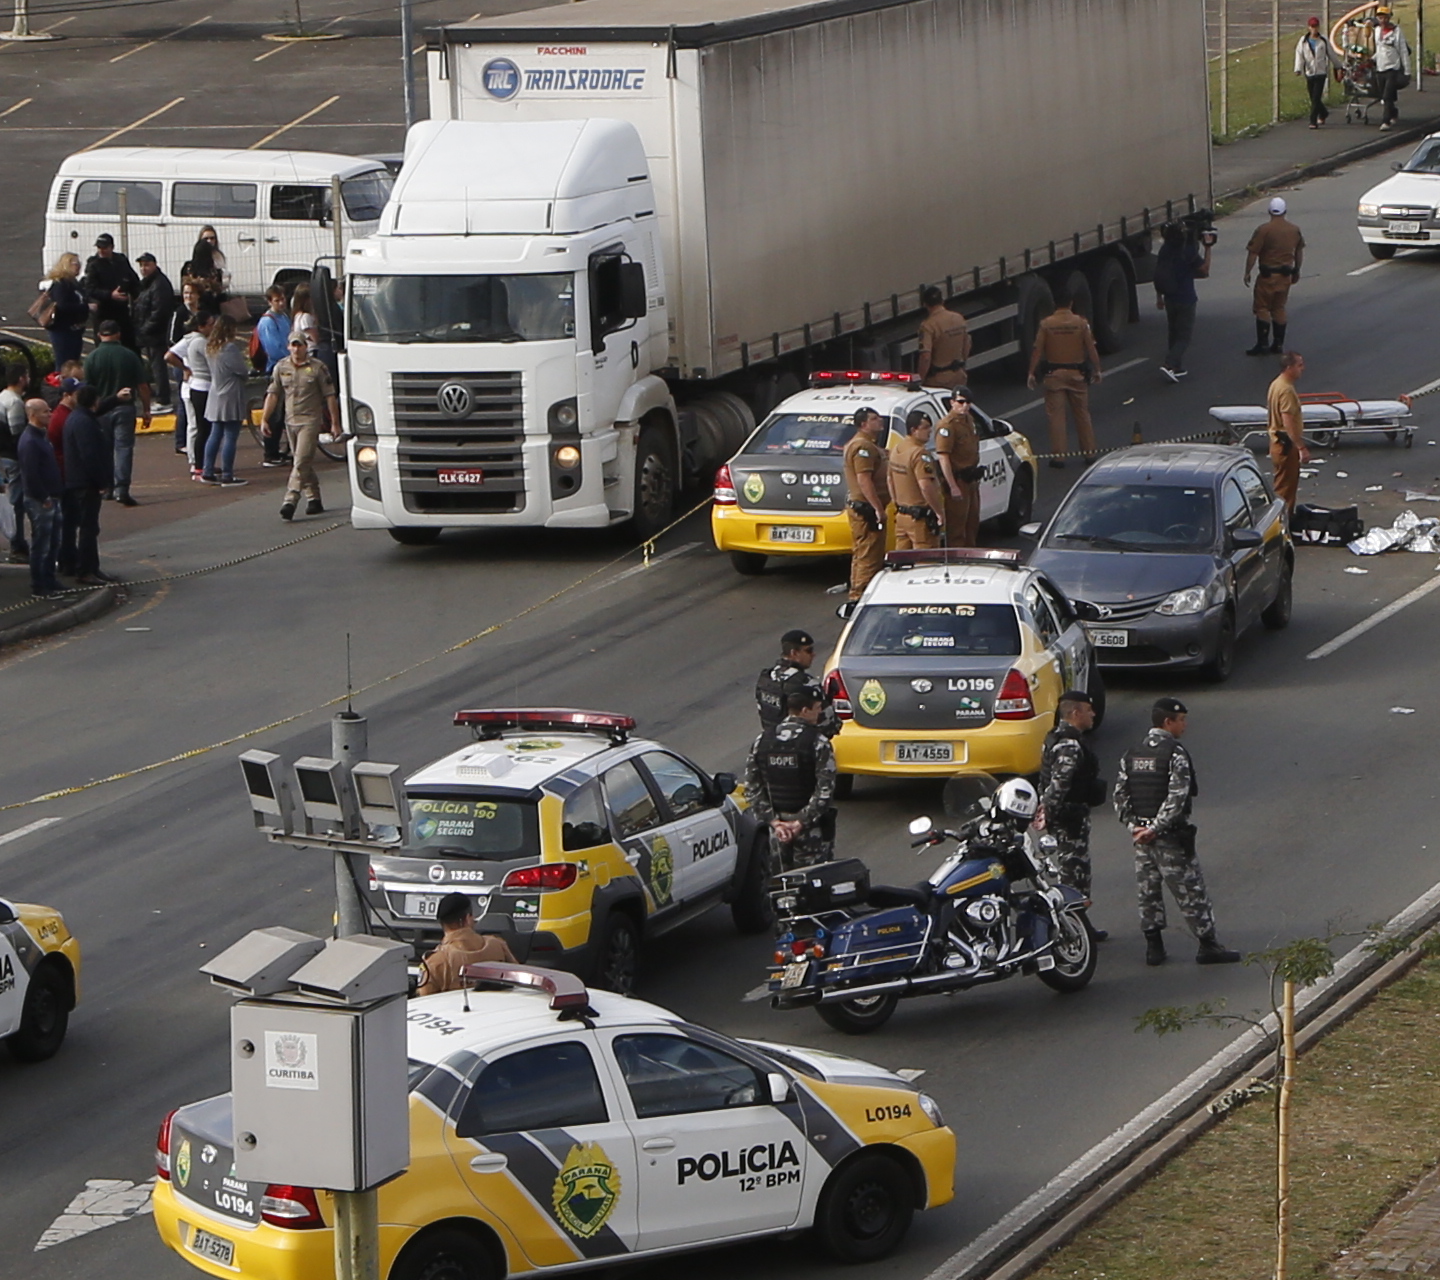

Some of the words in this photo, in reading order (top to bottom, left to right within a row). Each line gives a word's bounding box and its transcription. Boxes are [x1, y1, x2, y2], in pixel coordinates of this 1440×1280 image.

[537, 46, 587, 55] FACCHINI
[487, 69, 515, 90] TRC
[438, 473, 481, 484] CLK-6427
[899, 605, 952, 616] POLÍCIA
[956, 708, 986, 717] PARANÁ
[898, 746, 951, 760] BAT-4559
[769, 756, 795, 766] BOPE
[1133, 759, 1155, 770] BOPE
[413, 800, 469, 815] POLÍCIA
[473, 808, 497, 820] 190
[438, 819, 475, 829] PARANÁ
[436, 827, 475, 837] SEGURO
[450, 869, 485, 881] 13262
[269, 1068, 316, 1081] CURITIBA
[676, 1139, 801, 1186] POLÍCIA
[563, 1165, 610, 1183] PARANÁ
[766, 1170, 801, 1189] BPM
[222, 1176, 248, 1192] PARANÁ
